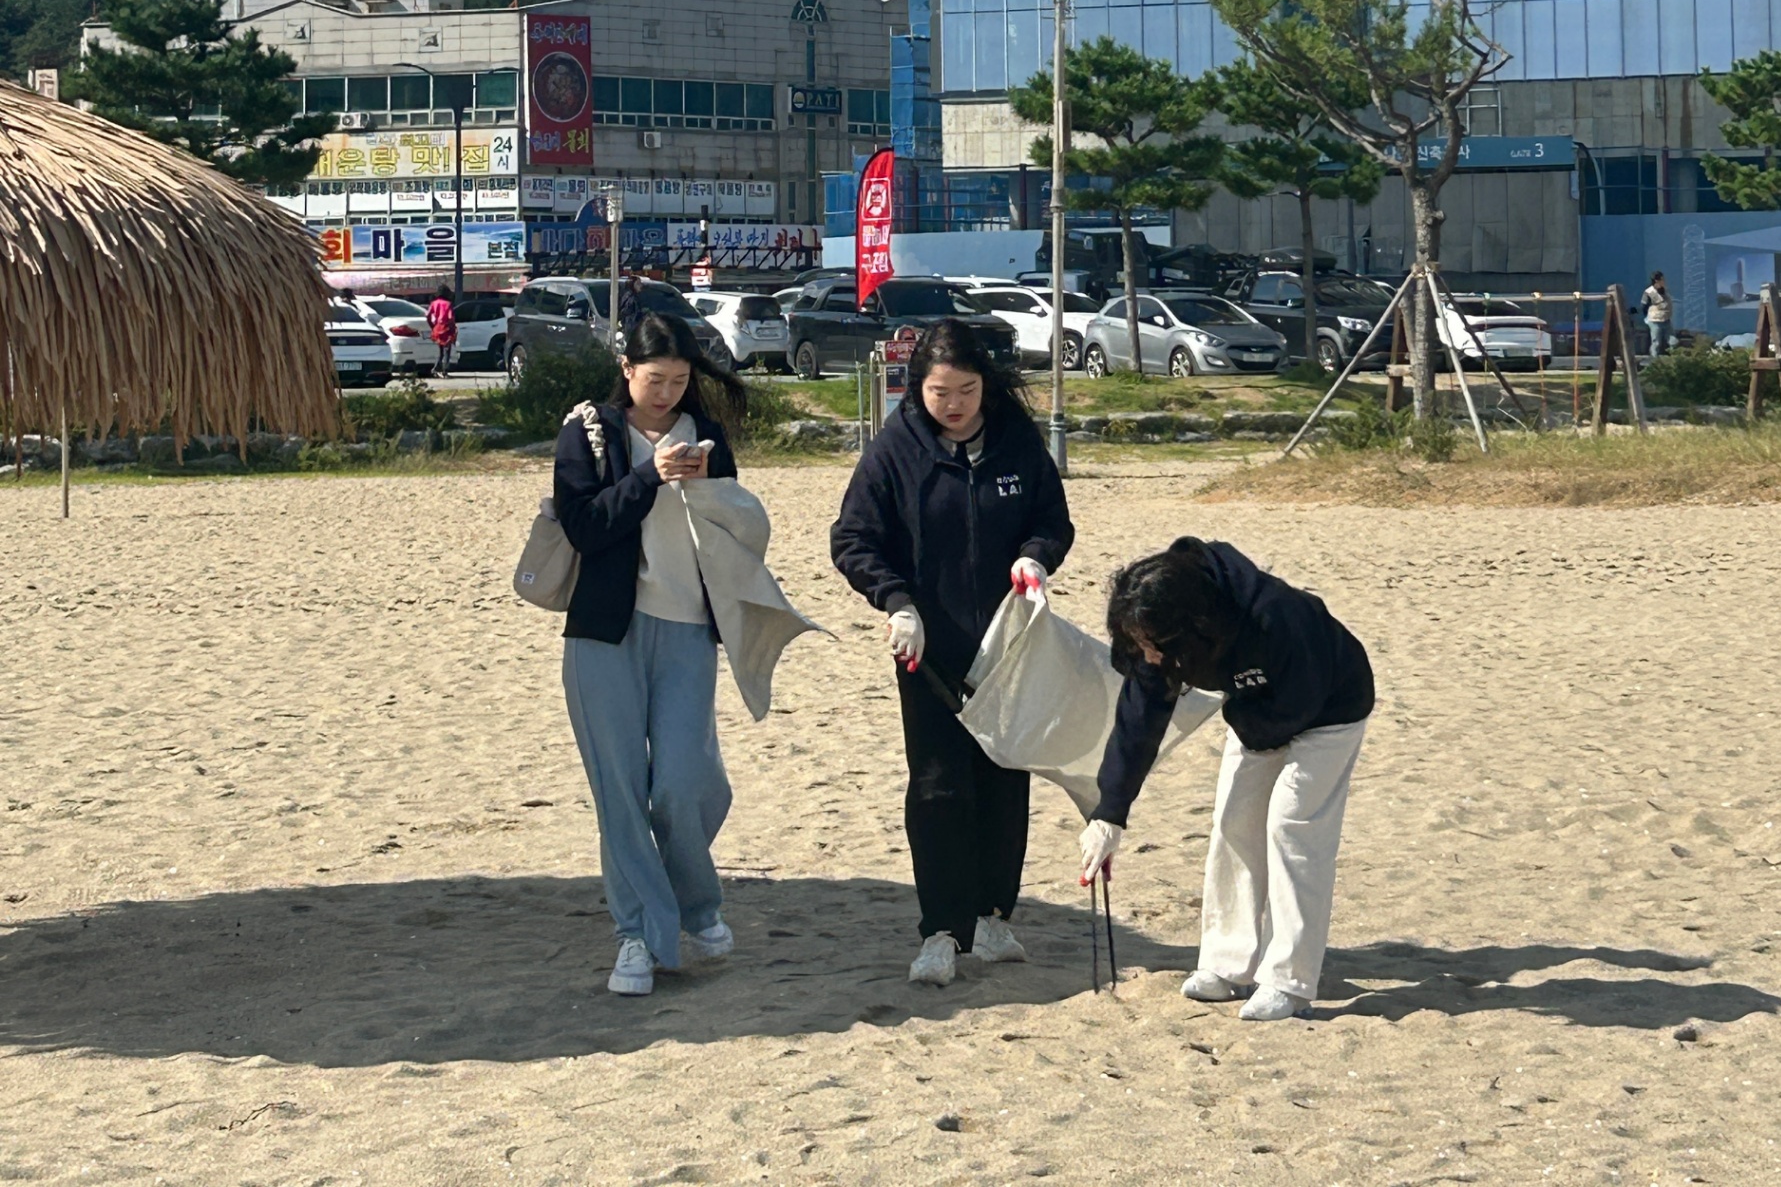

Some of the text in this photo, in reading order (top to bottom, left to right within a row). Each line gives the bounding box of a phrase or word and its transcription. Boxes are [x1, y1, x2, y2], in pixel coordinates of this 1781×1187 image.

[493, 136, 513, 154] 24
[1417, 144, 1471, 161] 신축사
[1534, 142, 1545, 158] 3
